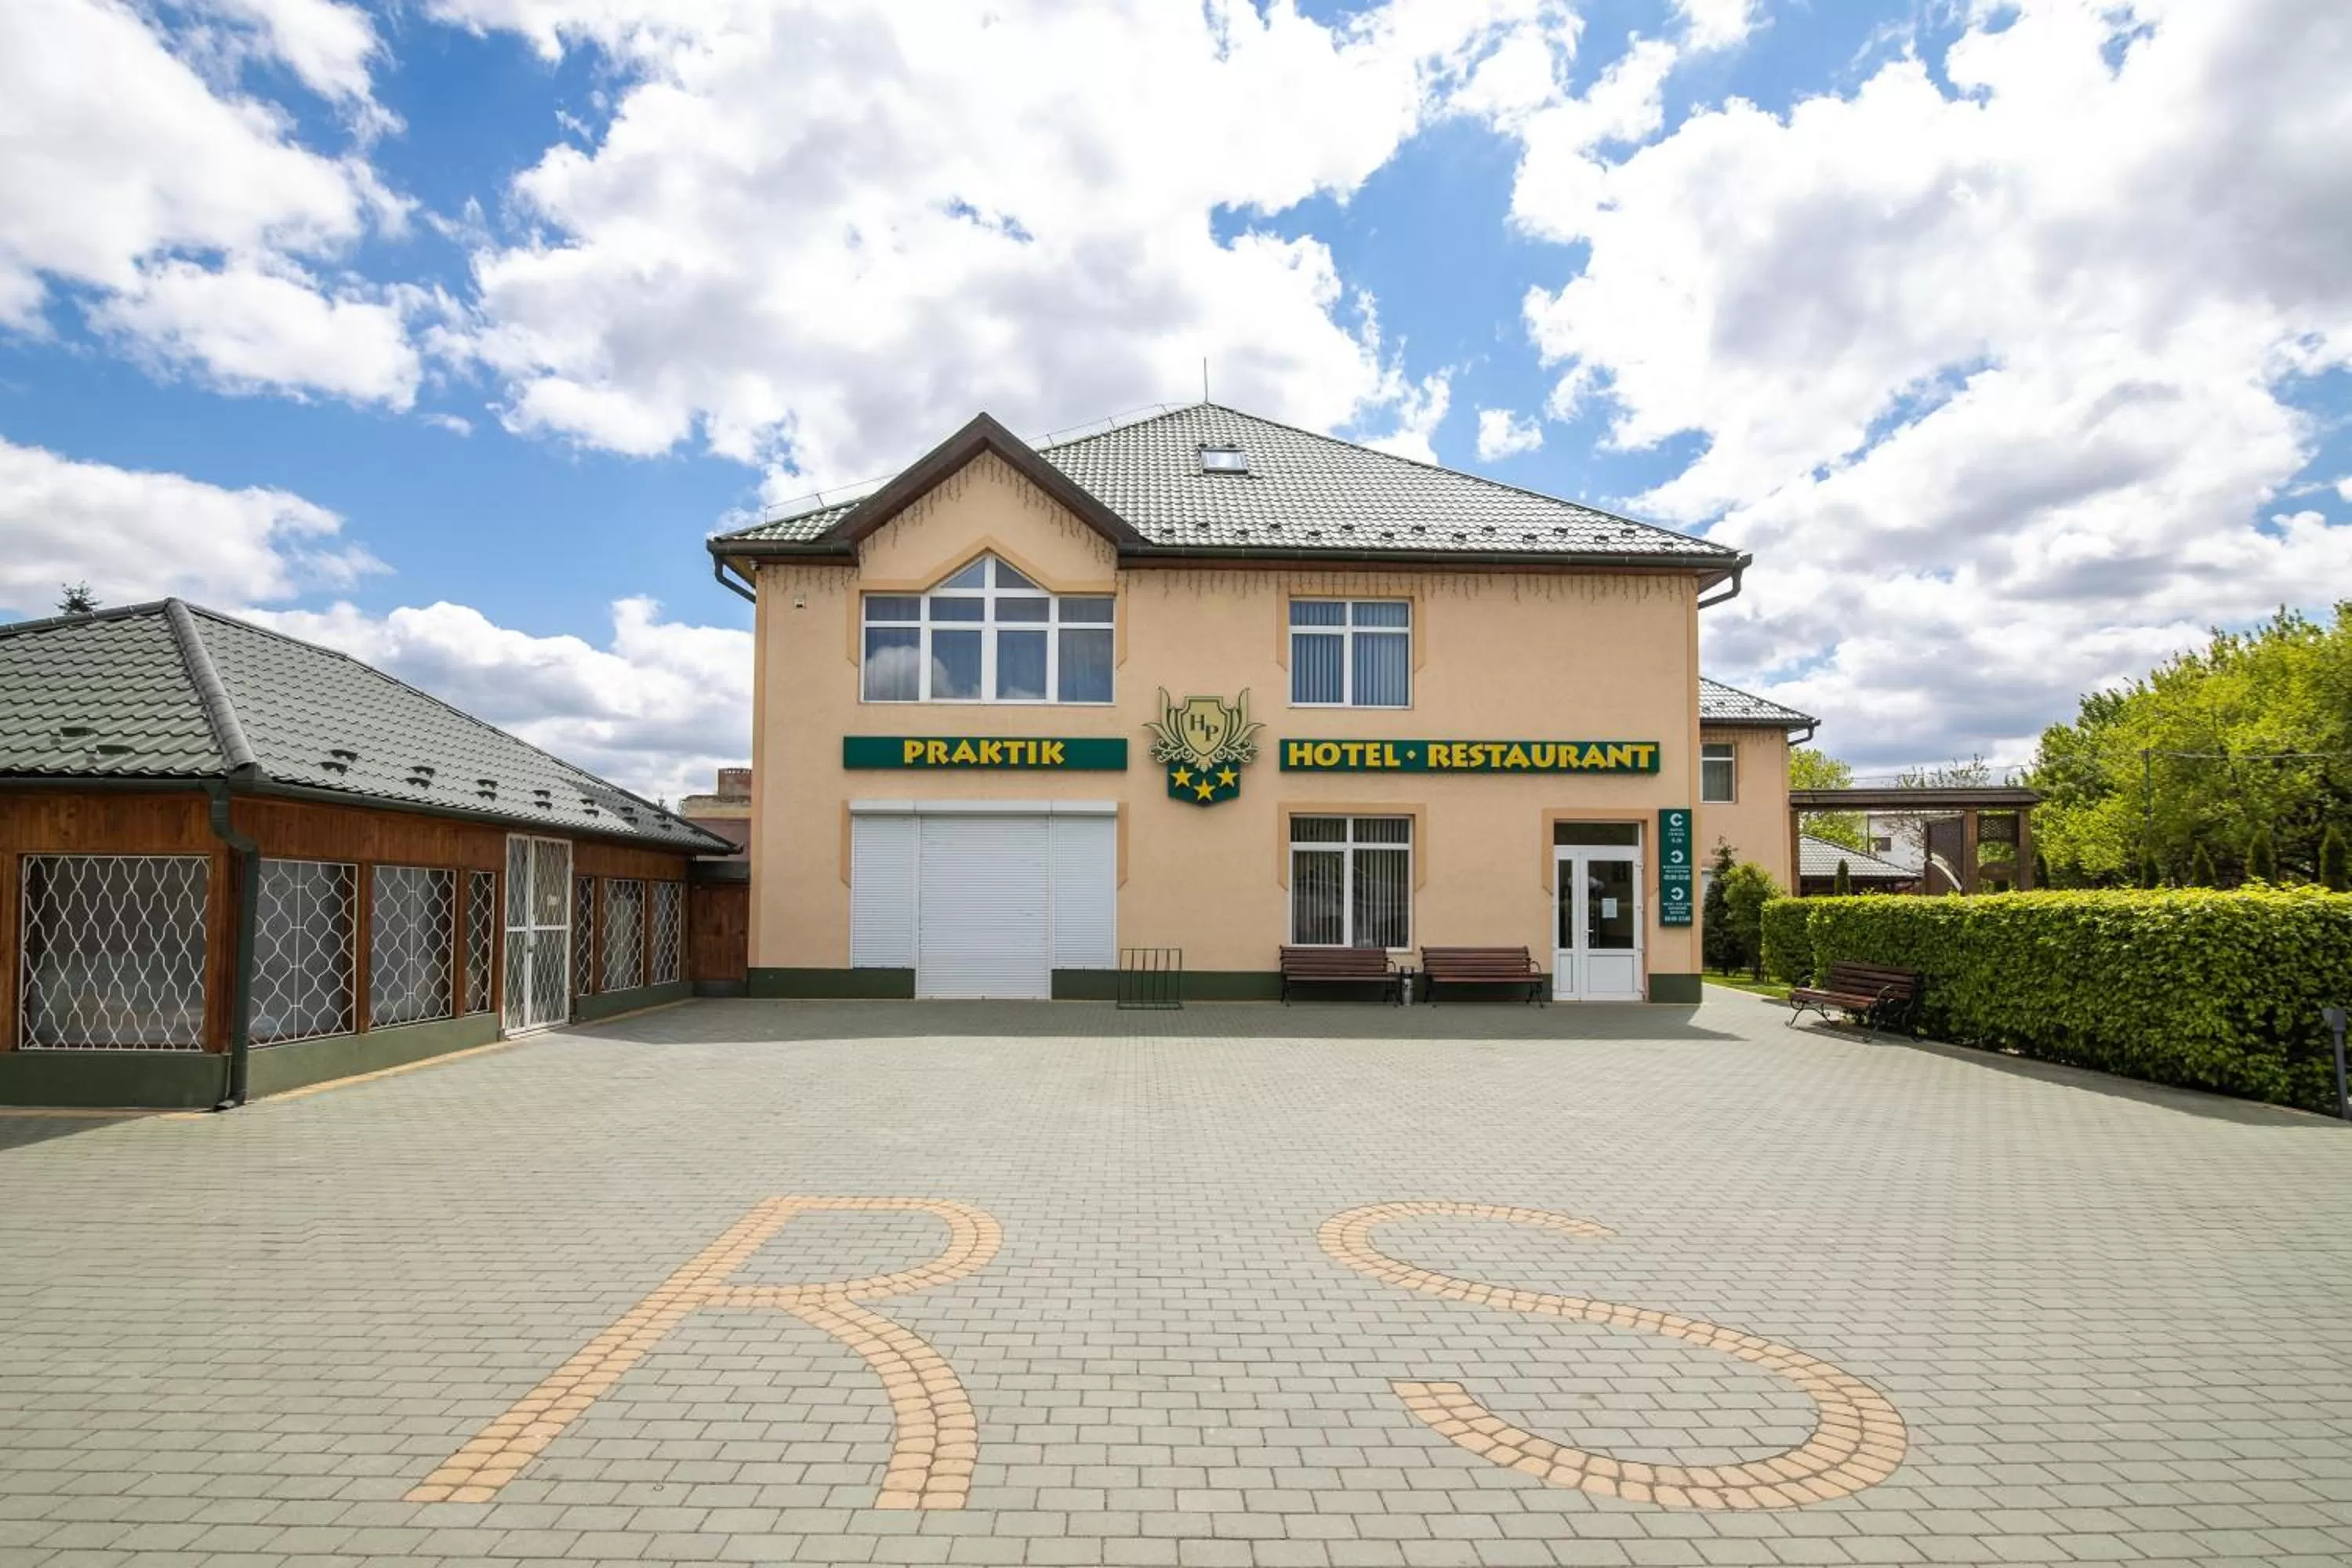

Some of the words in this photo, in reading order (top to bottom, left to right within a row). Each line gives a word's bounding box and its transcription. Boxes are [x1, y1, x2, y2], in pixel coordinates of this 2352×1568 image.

[903, 739, 1065, 765] PRAKTIK
[1287, 742, 1401, 767] HOTEL
[1427, 743, 1656, 768] RESTAURANT
